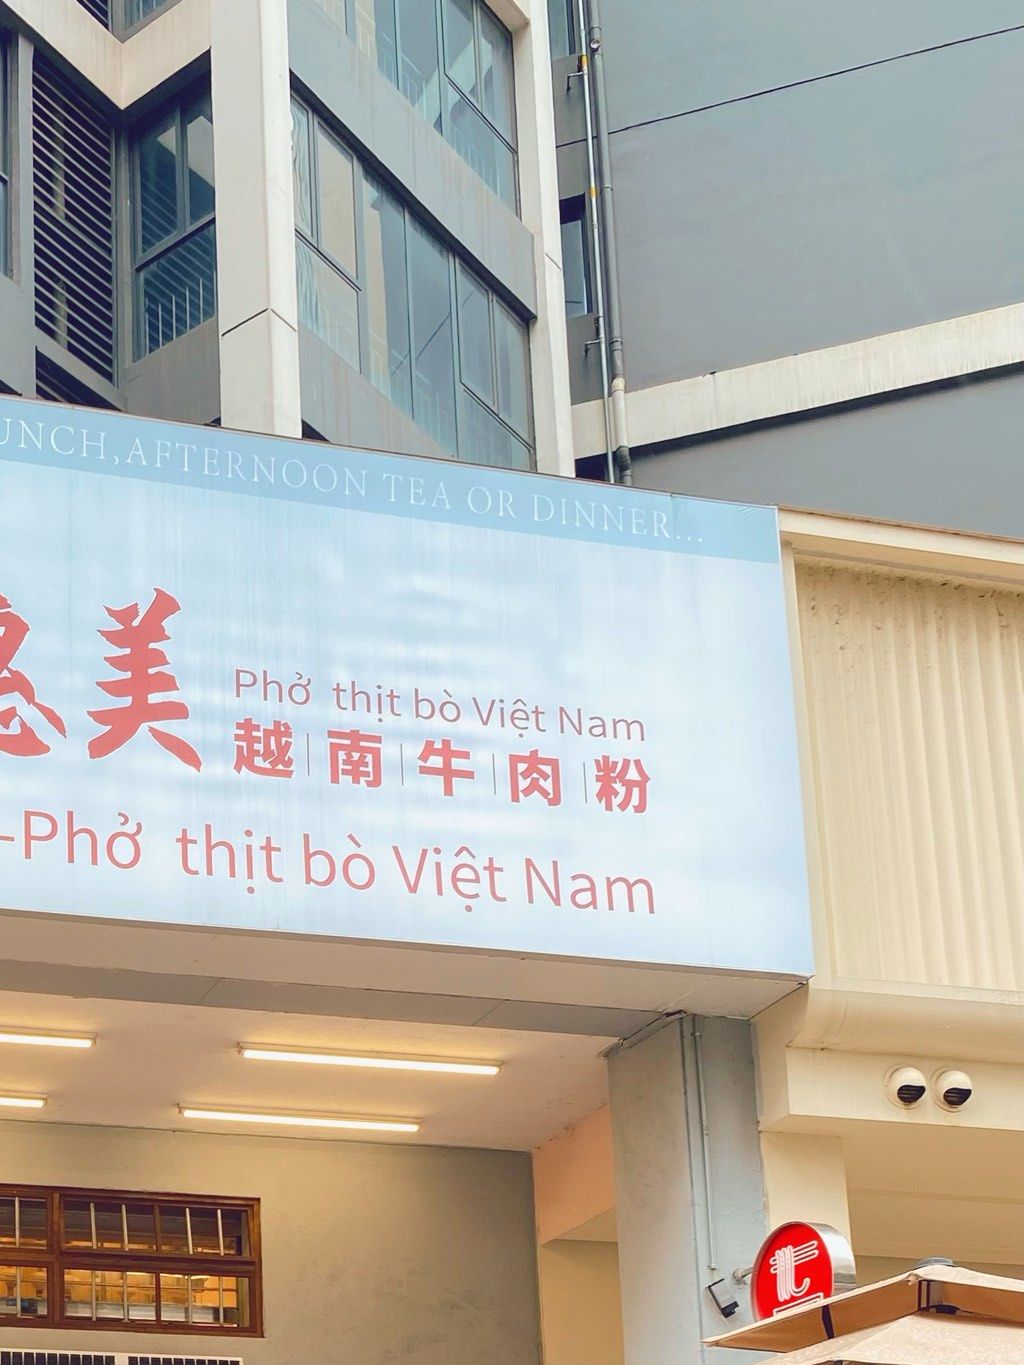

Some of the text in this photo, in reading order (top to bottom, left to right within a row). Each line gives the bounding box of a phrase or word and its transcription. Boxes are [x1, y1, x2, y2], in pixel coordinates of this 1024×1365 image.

[382, 473, 452, 510] TEA
[467, 486, 518, 518] OR
[234, 668, 647, 742] Phở thịt bò Việt Nam
[175, 825, 284, 895] thịt
[302, 832, 377, 892] bò
[391, 844, 508, 915] Việt
[523, 857, 657, 916] Nam
